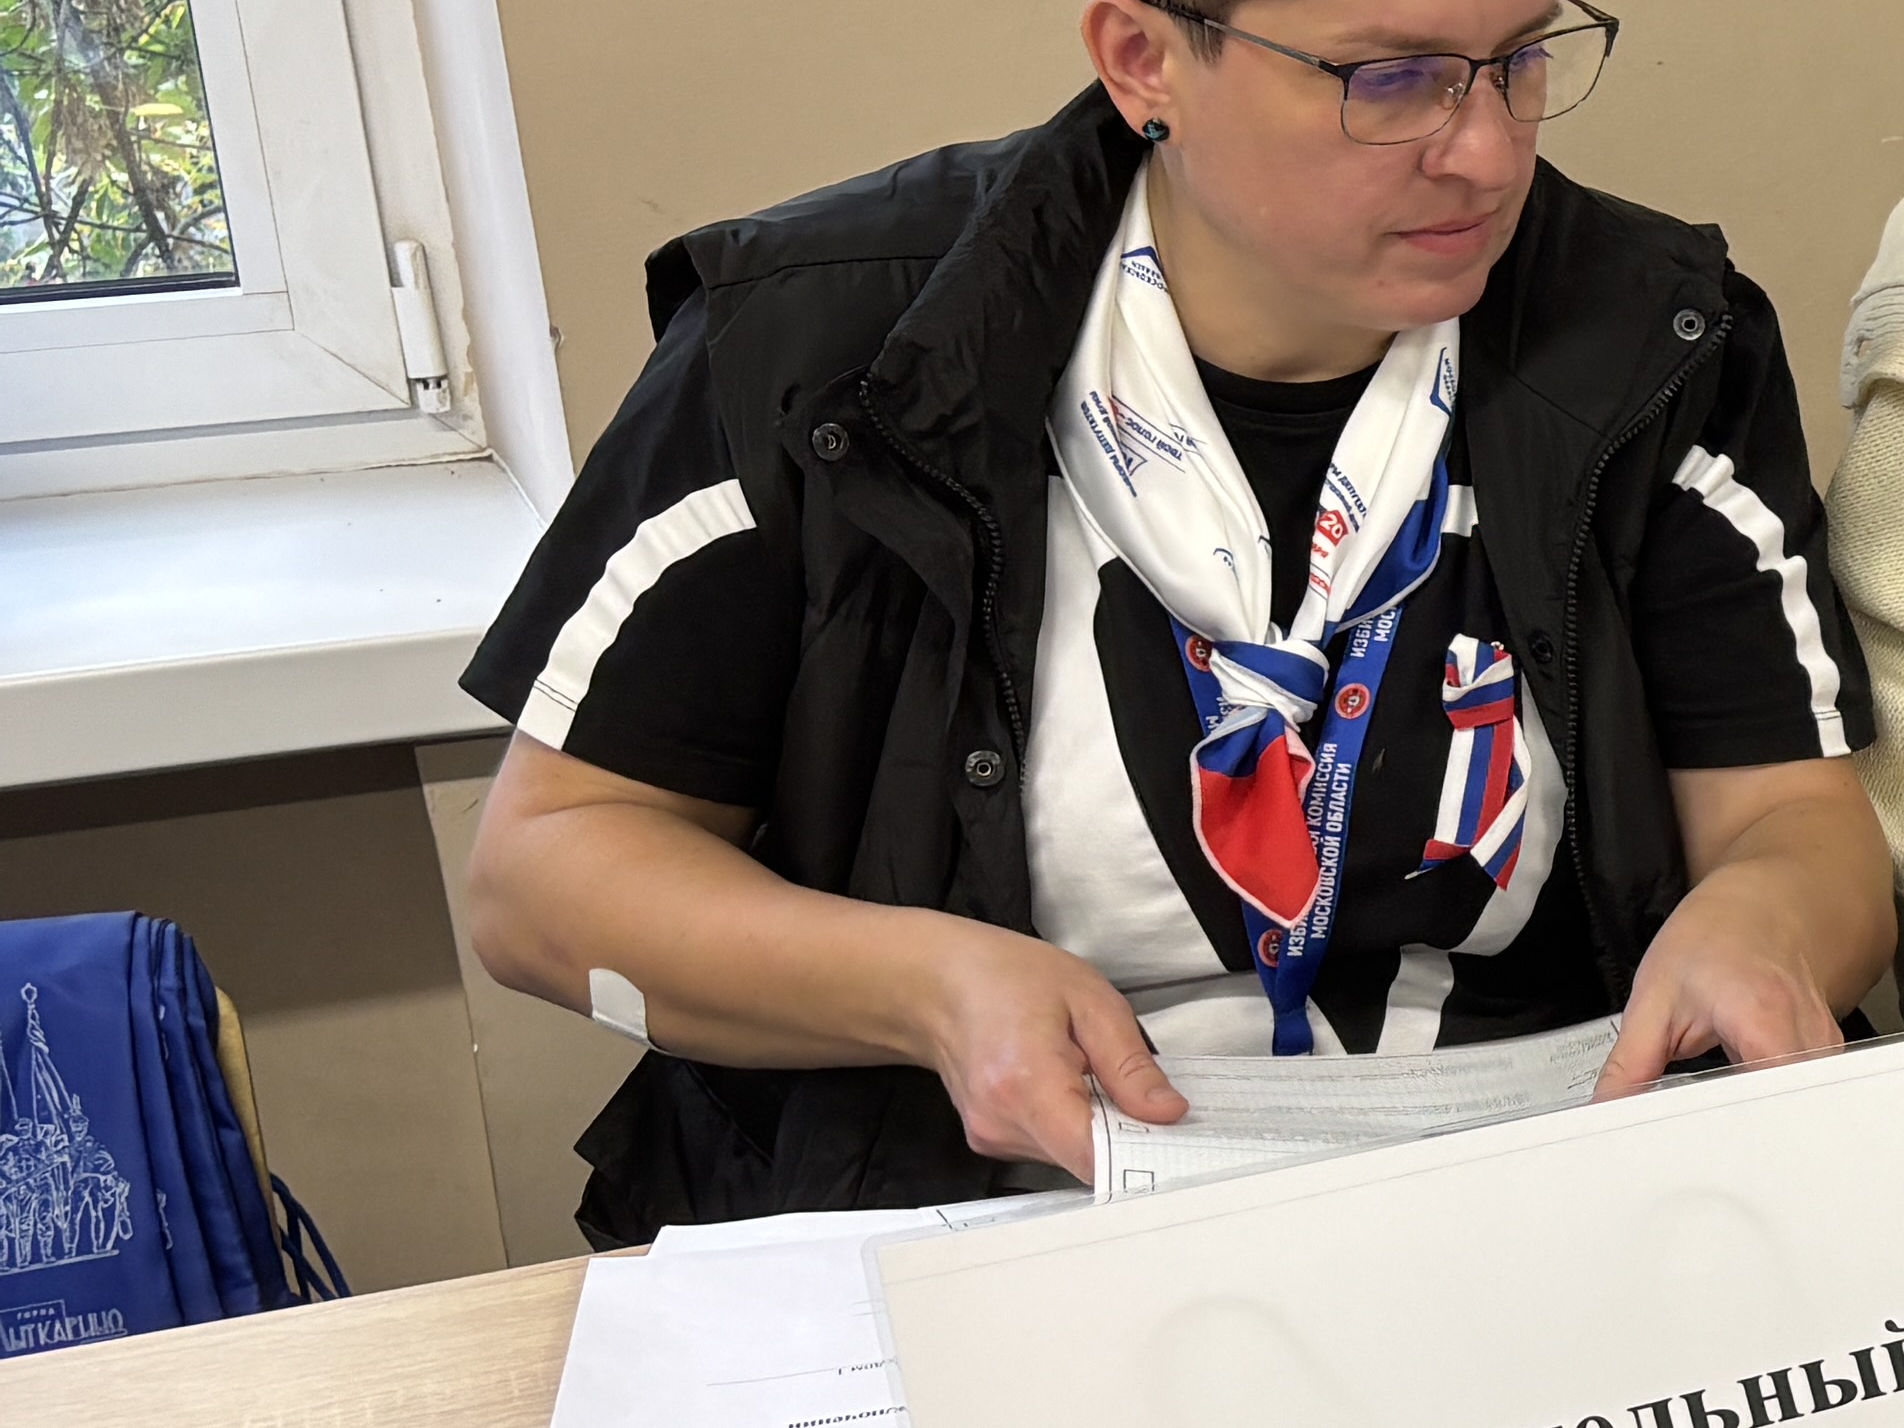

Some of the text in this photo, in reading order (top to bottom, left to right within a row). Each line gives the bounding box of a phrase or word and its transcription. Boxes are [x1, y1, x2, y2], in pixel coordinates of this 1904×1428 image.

[1318, 510, 1346, 539] 20
[1306, 741, 1337, 826] КОМИССИЯ
[1310, 835, 1341, 938] МОСКОВСКОЙ
[1327, 762, 1351, 832] ОБЛАСТИ
